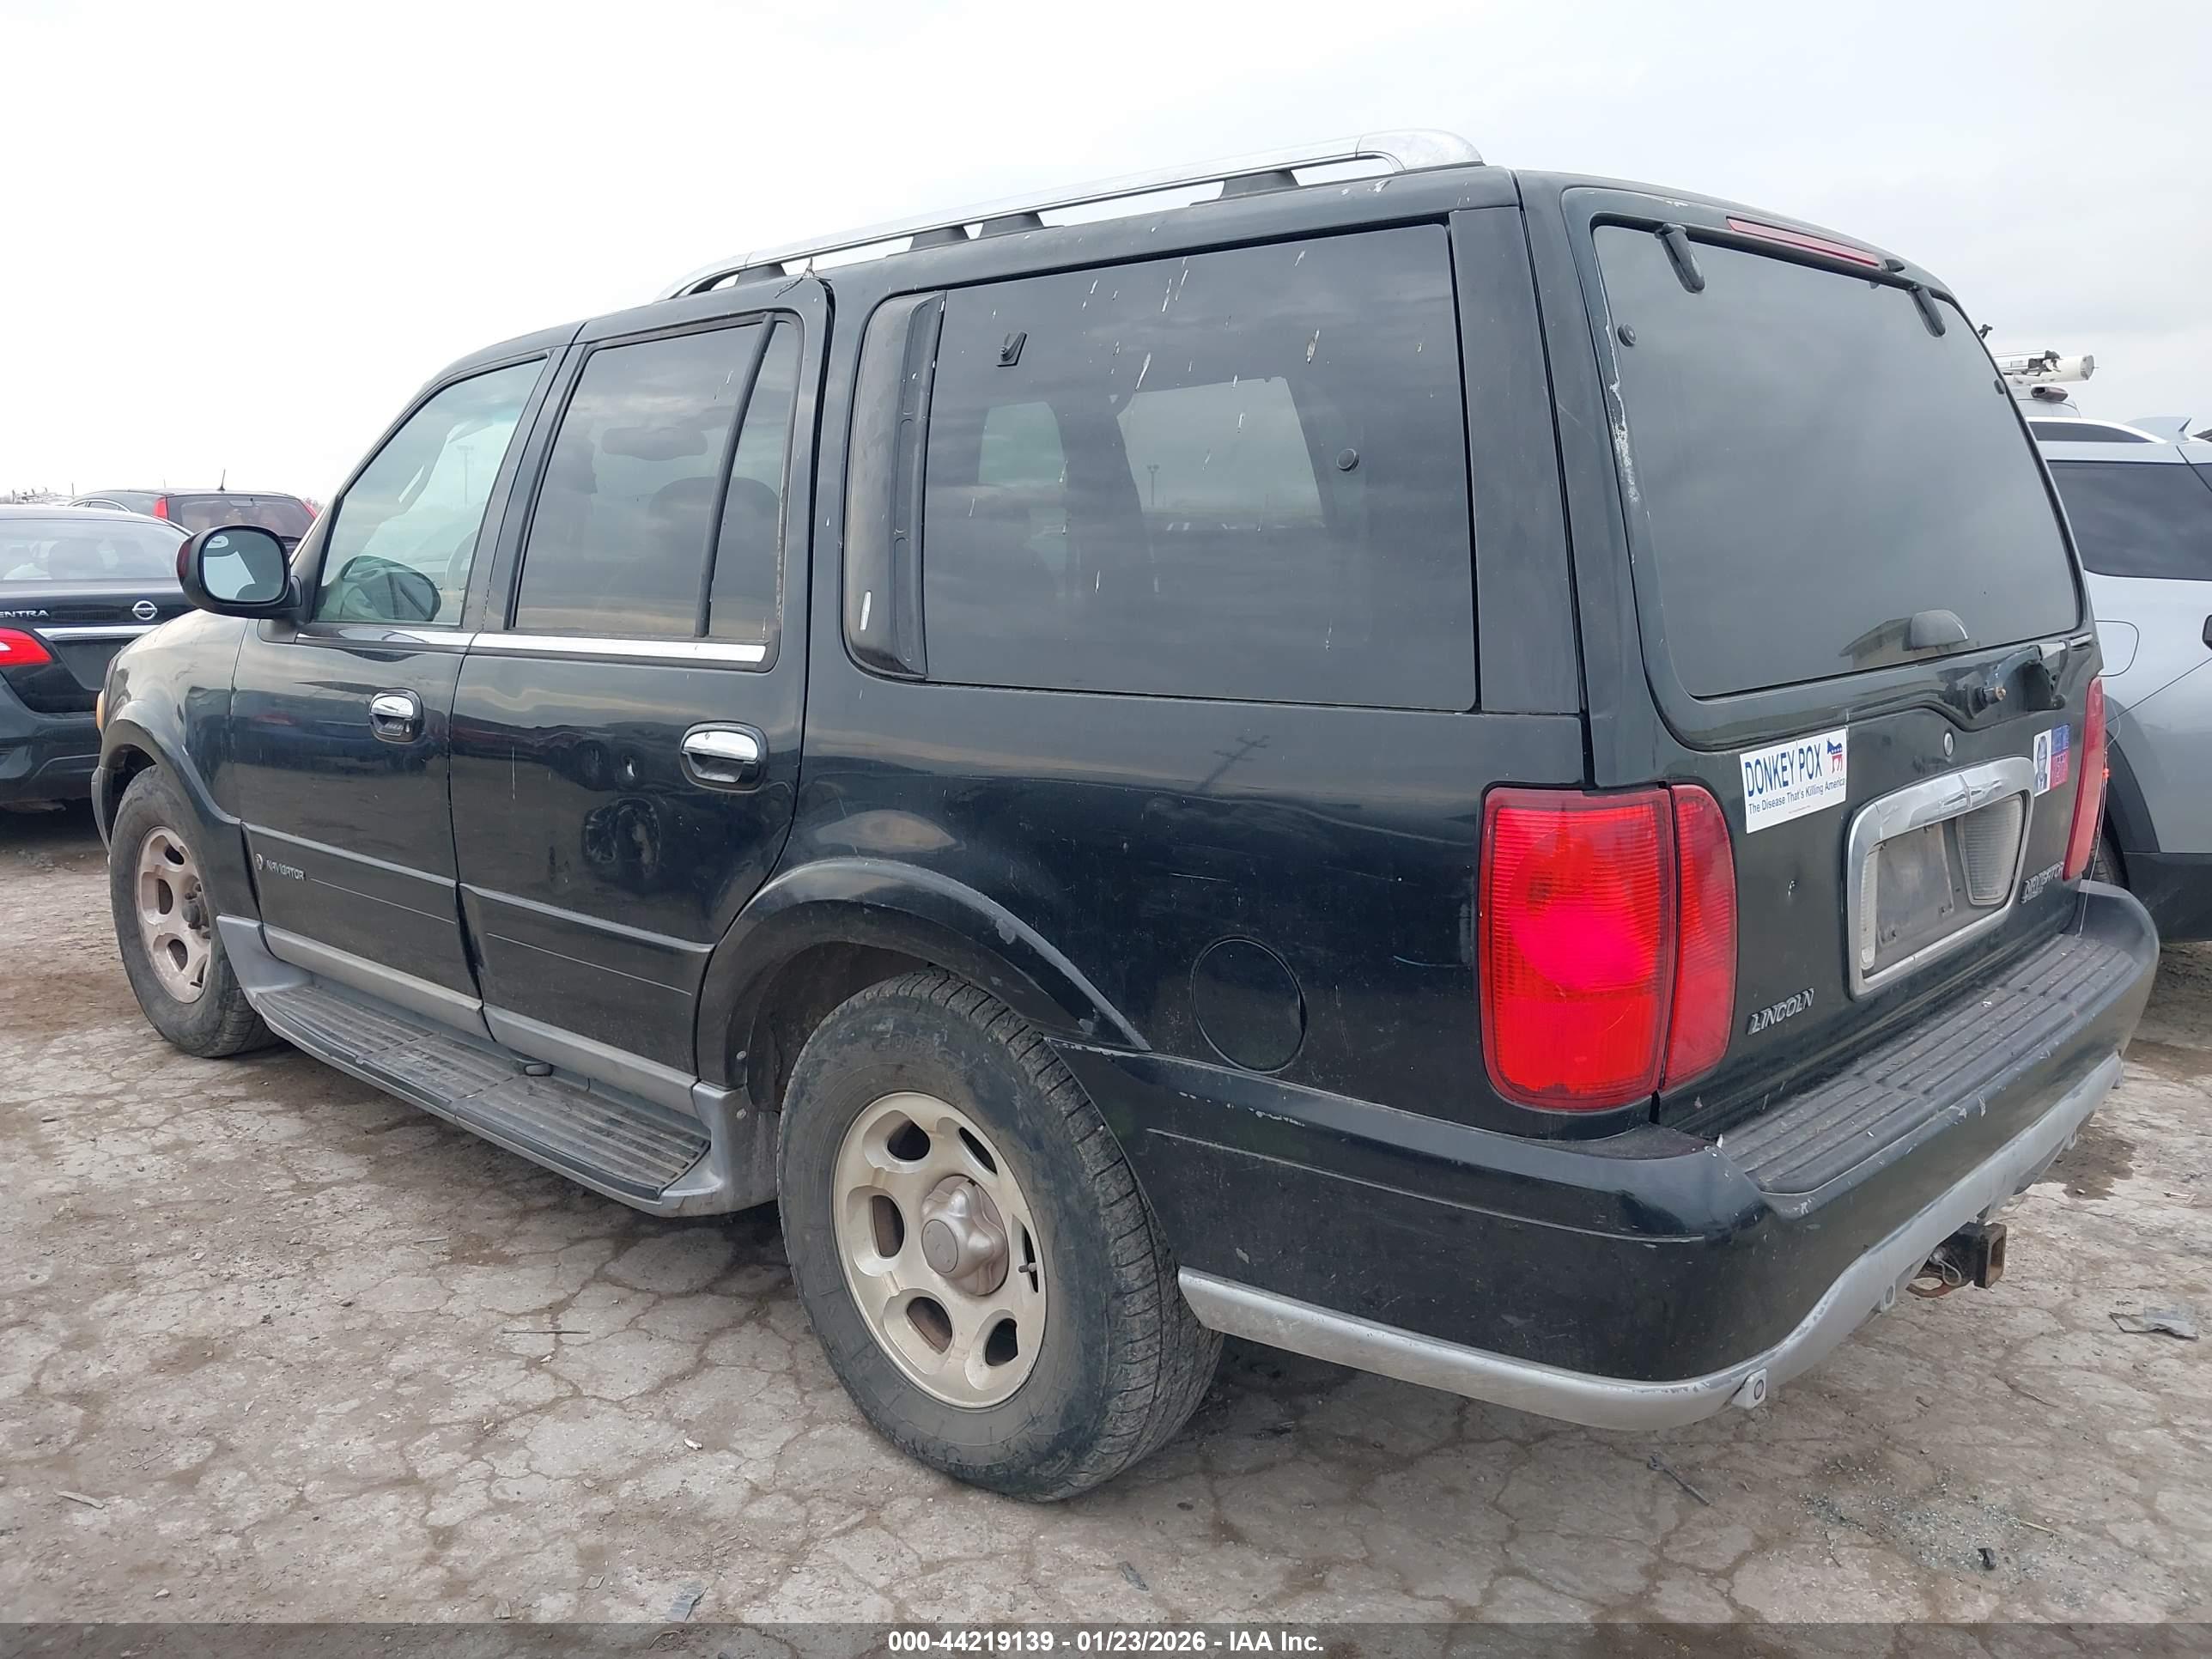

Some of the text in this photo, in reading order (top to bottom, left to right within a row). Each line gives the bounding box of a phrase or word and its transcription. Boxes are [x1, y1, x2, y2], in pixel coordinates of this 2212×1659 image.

[1745, 743, 1822, 797] DONKEY POX
[1748, 803, 1760, 815] The
[1761, 796, 1786, 811] Disease
[1787, 789, 1805, 802] That's
[1805, 783, 1824, 796] Killing
[1825, 777, 1845, 791] America
[266, 860, 305, 881] NAVIGATOR
[1747, 988, 1814, 1036] LINCOLN
